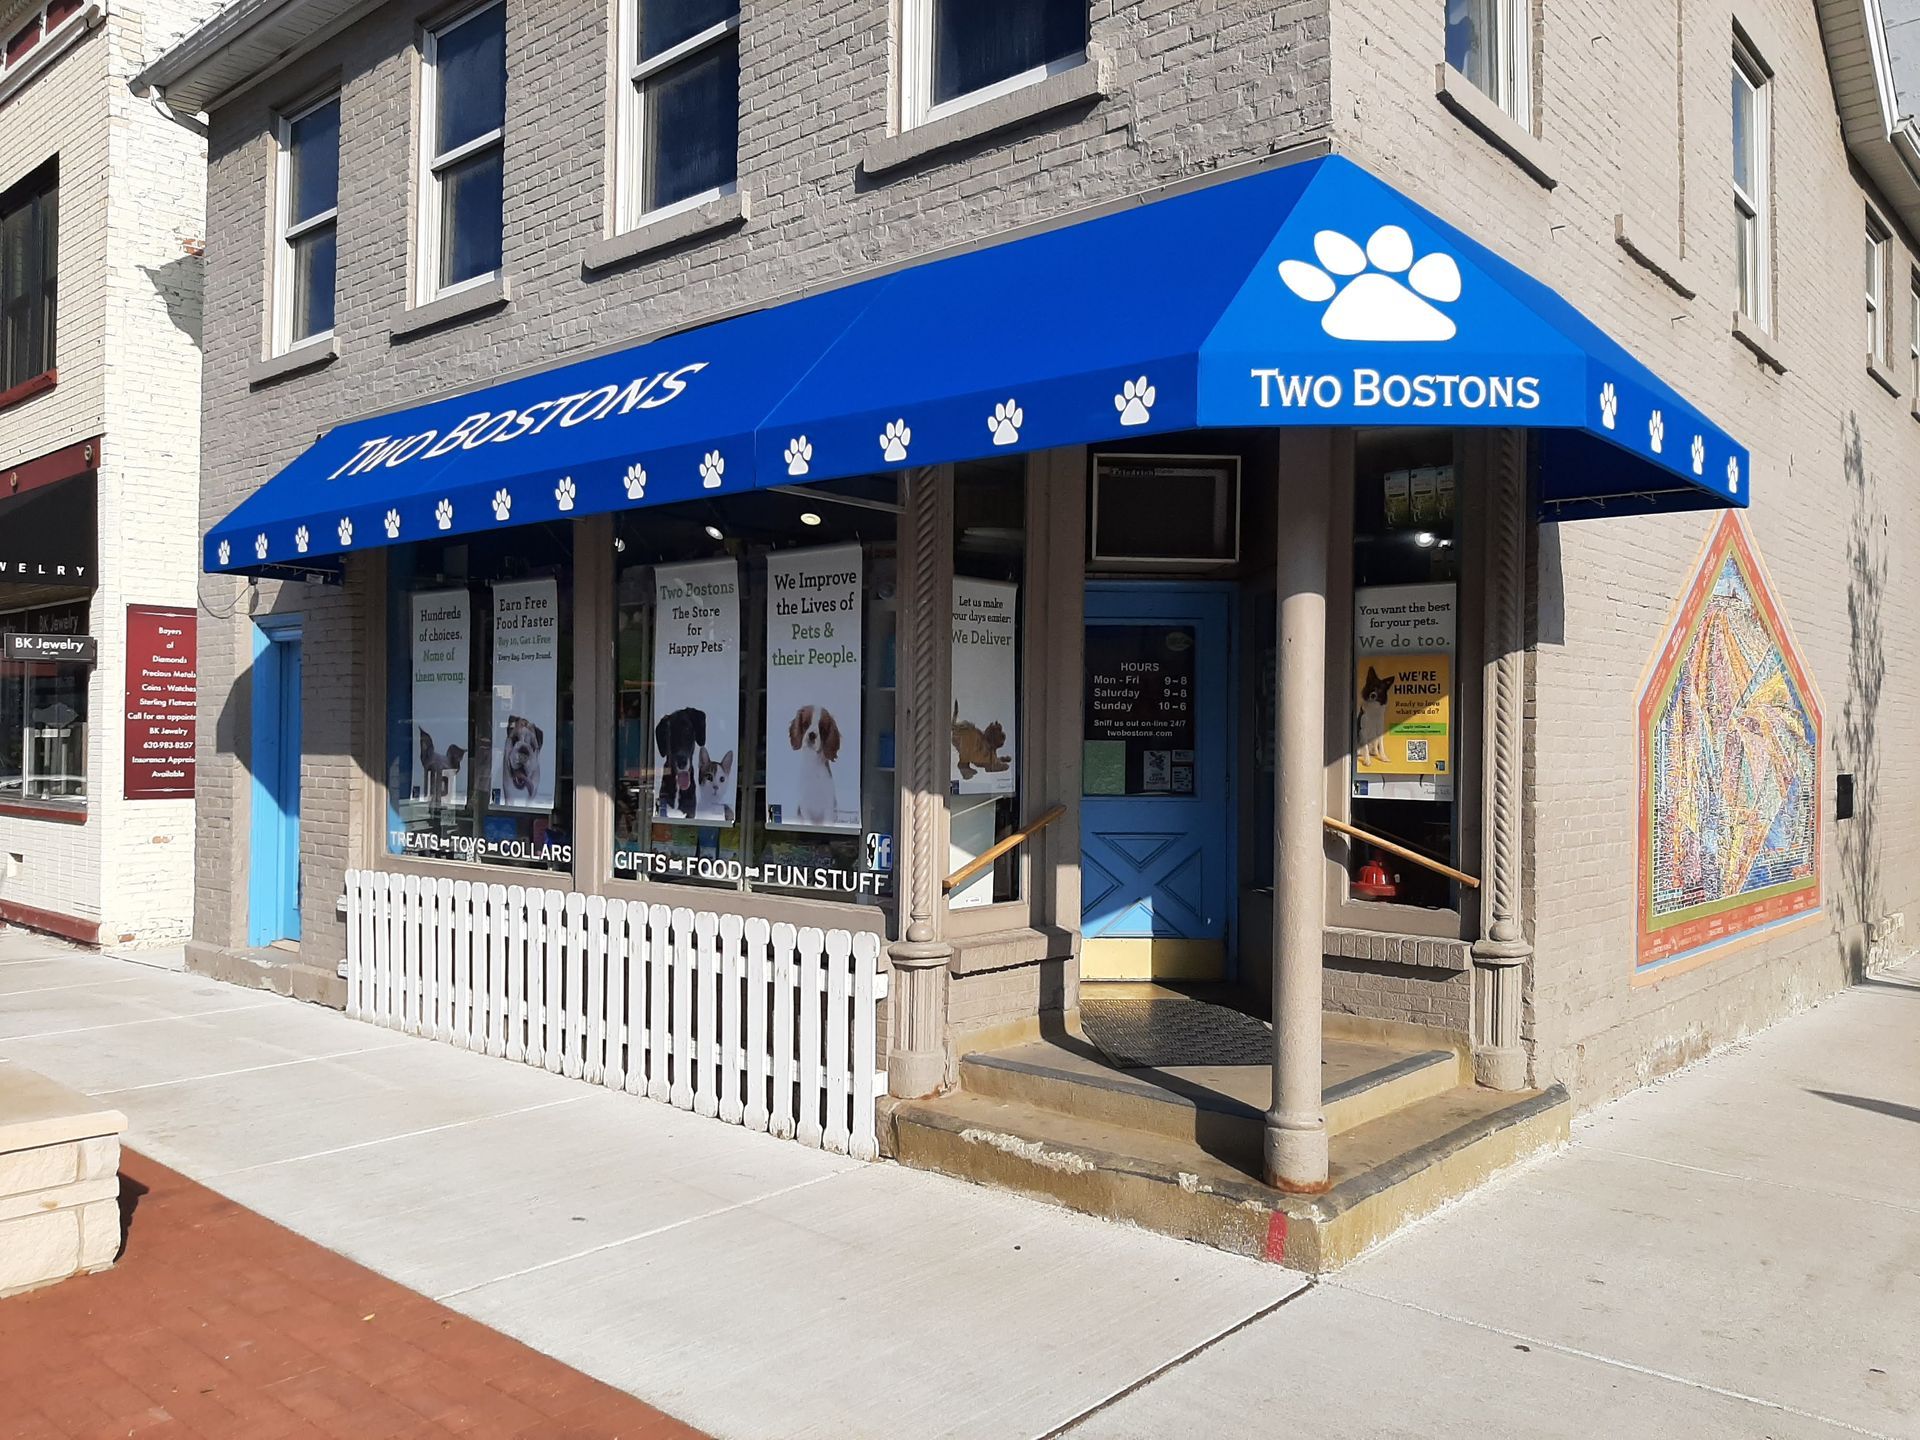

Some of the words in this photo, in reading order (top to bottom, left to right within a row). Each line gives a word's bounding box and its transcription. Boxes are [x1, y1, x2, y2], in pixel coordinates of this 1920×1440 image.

[1250, 367, 1342, 408] TWO
[1353, 367, 1540, 409] BOSTONS
[326, 430, 438, 480] TWO
[420, 362, 710, 460] BOSTONS
[774, 574, 796, 590] We
[799, 571, 857, 592] Improve
[660, 584, 684, 600] Two
[686, 582, 735, 598] Bostons
[500, 598, 522, 612] Earn
[525, 596, 548, 610] Free
[776, 599, 798, 616] the
[801, 596, 836, 614] Lives
[840, 592, 854, 611] of
[958, 596, 971, 606] Let
[972, 600, 982, 608] us
[983, 597, 1004, 609] make
[1360, 606, 1379, 615] You
[1380, 604, 1406, 614] want
[1408, 602, 1426, 613] the
[1428, 602, 1451, 612] best
[420, 606, 462, 622] Hundreds
[672, 608, 690, 620] The
[692, 606, 720, 618] Store
[968, 610, 986, 624] days
[496, 617, 518, 630] Food
[521, 615, 555, 630] Faster
[687, 623, 702, 636] for
[1370, 618, 1386, 628] for
[1386, 620, 1412, 630] your
[1413, 617, 1439, 628] pets.
[419, 629, 428, 642] of
[428, 628, 463, 642] choices.
[792, 623, 821, 640] Pets
[824, 622, 834, 638] &
[952, 629, 968, 644] We
[971, 629, 1012, 646] Deliver
[15, 638, 33, 649] BK
[36, 638, 84, 653] Jewelry
[536, 634, 552, 644] Free
[1359, 635, 1384, 648] We
[1390, 634, 1411, 648] do
[1417, 635, 1450, 647] too.
[423, 650, 444, 663] None
[446, 647, 455, 661] of
[668, 642, 699, 656] Happy
[152, 655, 188, 664] Diamonds
[772, 647, 805, 666] their
[808, 645, 857, 668] People.
[142, 669, 172, 677] Precious
[1120, 662, 1160, 672] HOURS
[415, 670, 435, 683] them
[436, 671, 466, 684] wrong.
[1094, 675, 1116, 684] Mon
[1126, 675, 1140, 684] Fri
[1164, 676, 1171, 686] 9
[1180, 676, 1188, 686] 8
[1398, 670, 1437, 682] WE'RE
[167, 684, 196, 692] Watches
[1094, 688, 1140, 699] Saturday
[1164, 688, 1170, 698] 9
[1180, 690, 1188, 698] 8
[1394, 684, 1441, 695] HIRING!
[1094, 701, 1133, 712] Sunday
[1159, 702, 1170, 711] 10
[1180, 702, 1186, 711] 6
[1395, 700, 1416, 708] Ready
[127, 712, 142, 720] Call
[144, 712, 154, 720] for
[161, 728, 188, 736] Jewelry
[152, 770, 185, 778] Available
[390, 831, 440, 850] TREATS
[450, 836, 486, 854] TOYS
[500, 840, 572, 863] COLLARS
[614, 851, 666, 873] GIFTS
[686, 856, 742, 881] FOOD
[763, 864, 808, 887] FUN
[814, 868, 888, 895] STUFF
